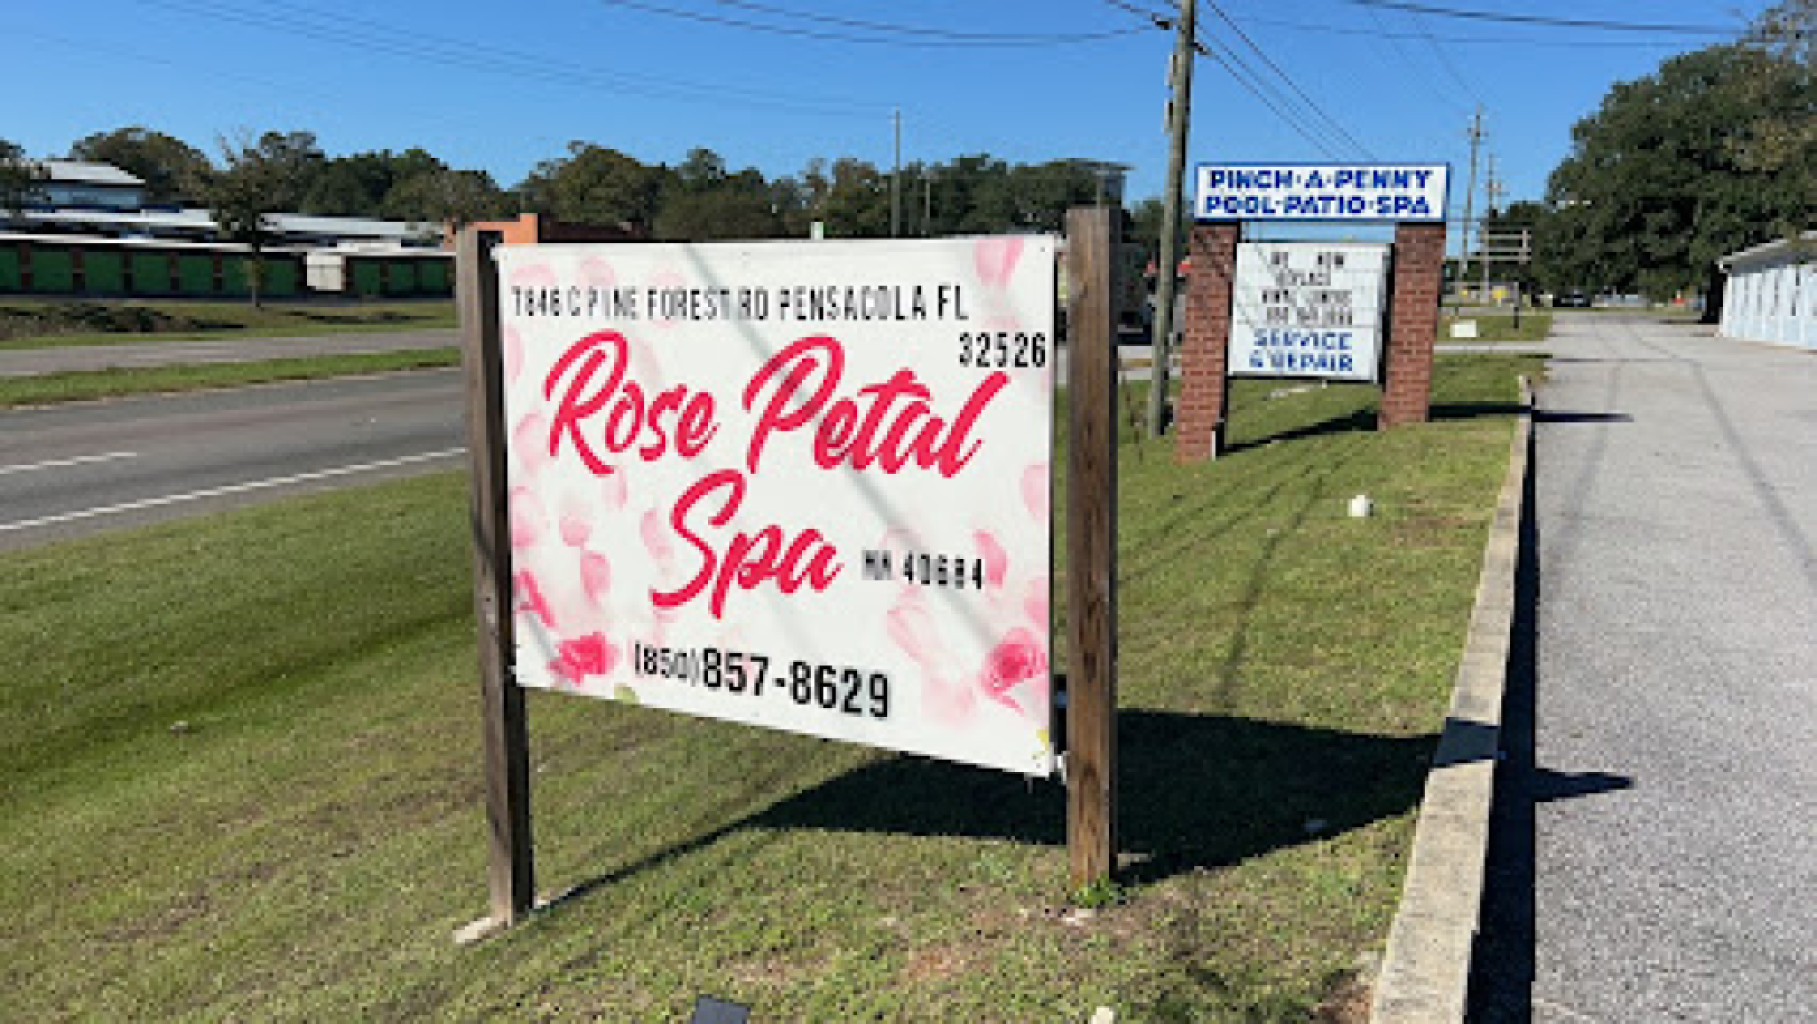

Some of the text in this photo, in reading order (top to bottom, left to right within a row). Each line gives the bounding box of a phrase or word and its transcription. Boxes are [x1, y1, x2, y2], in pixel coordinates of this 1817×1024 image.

[511, 284, 970, 321] 7846 C PINE FOREST RD PENSACOLA FL
[958, 331, 1047, 368] 32526
[543, 329, 1012, 479] Rose Petal
[649, 468, 844, 620] Spa
